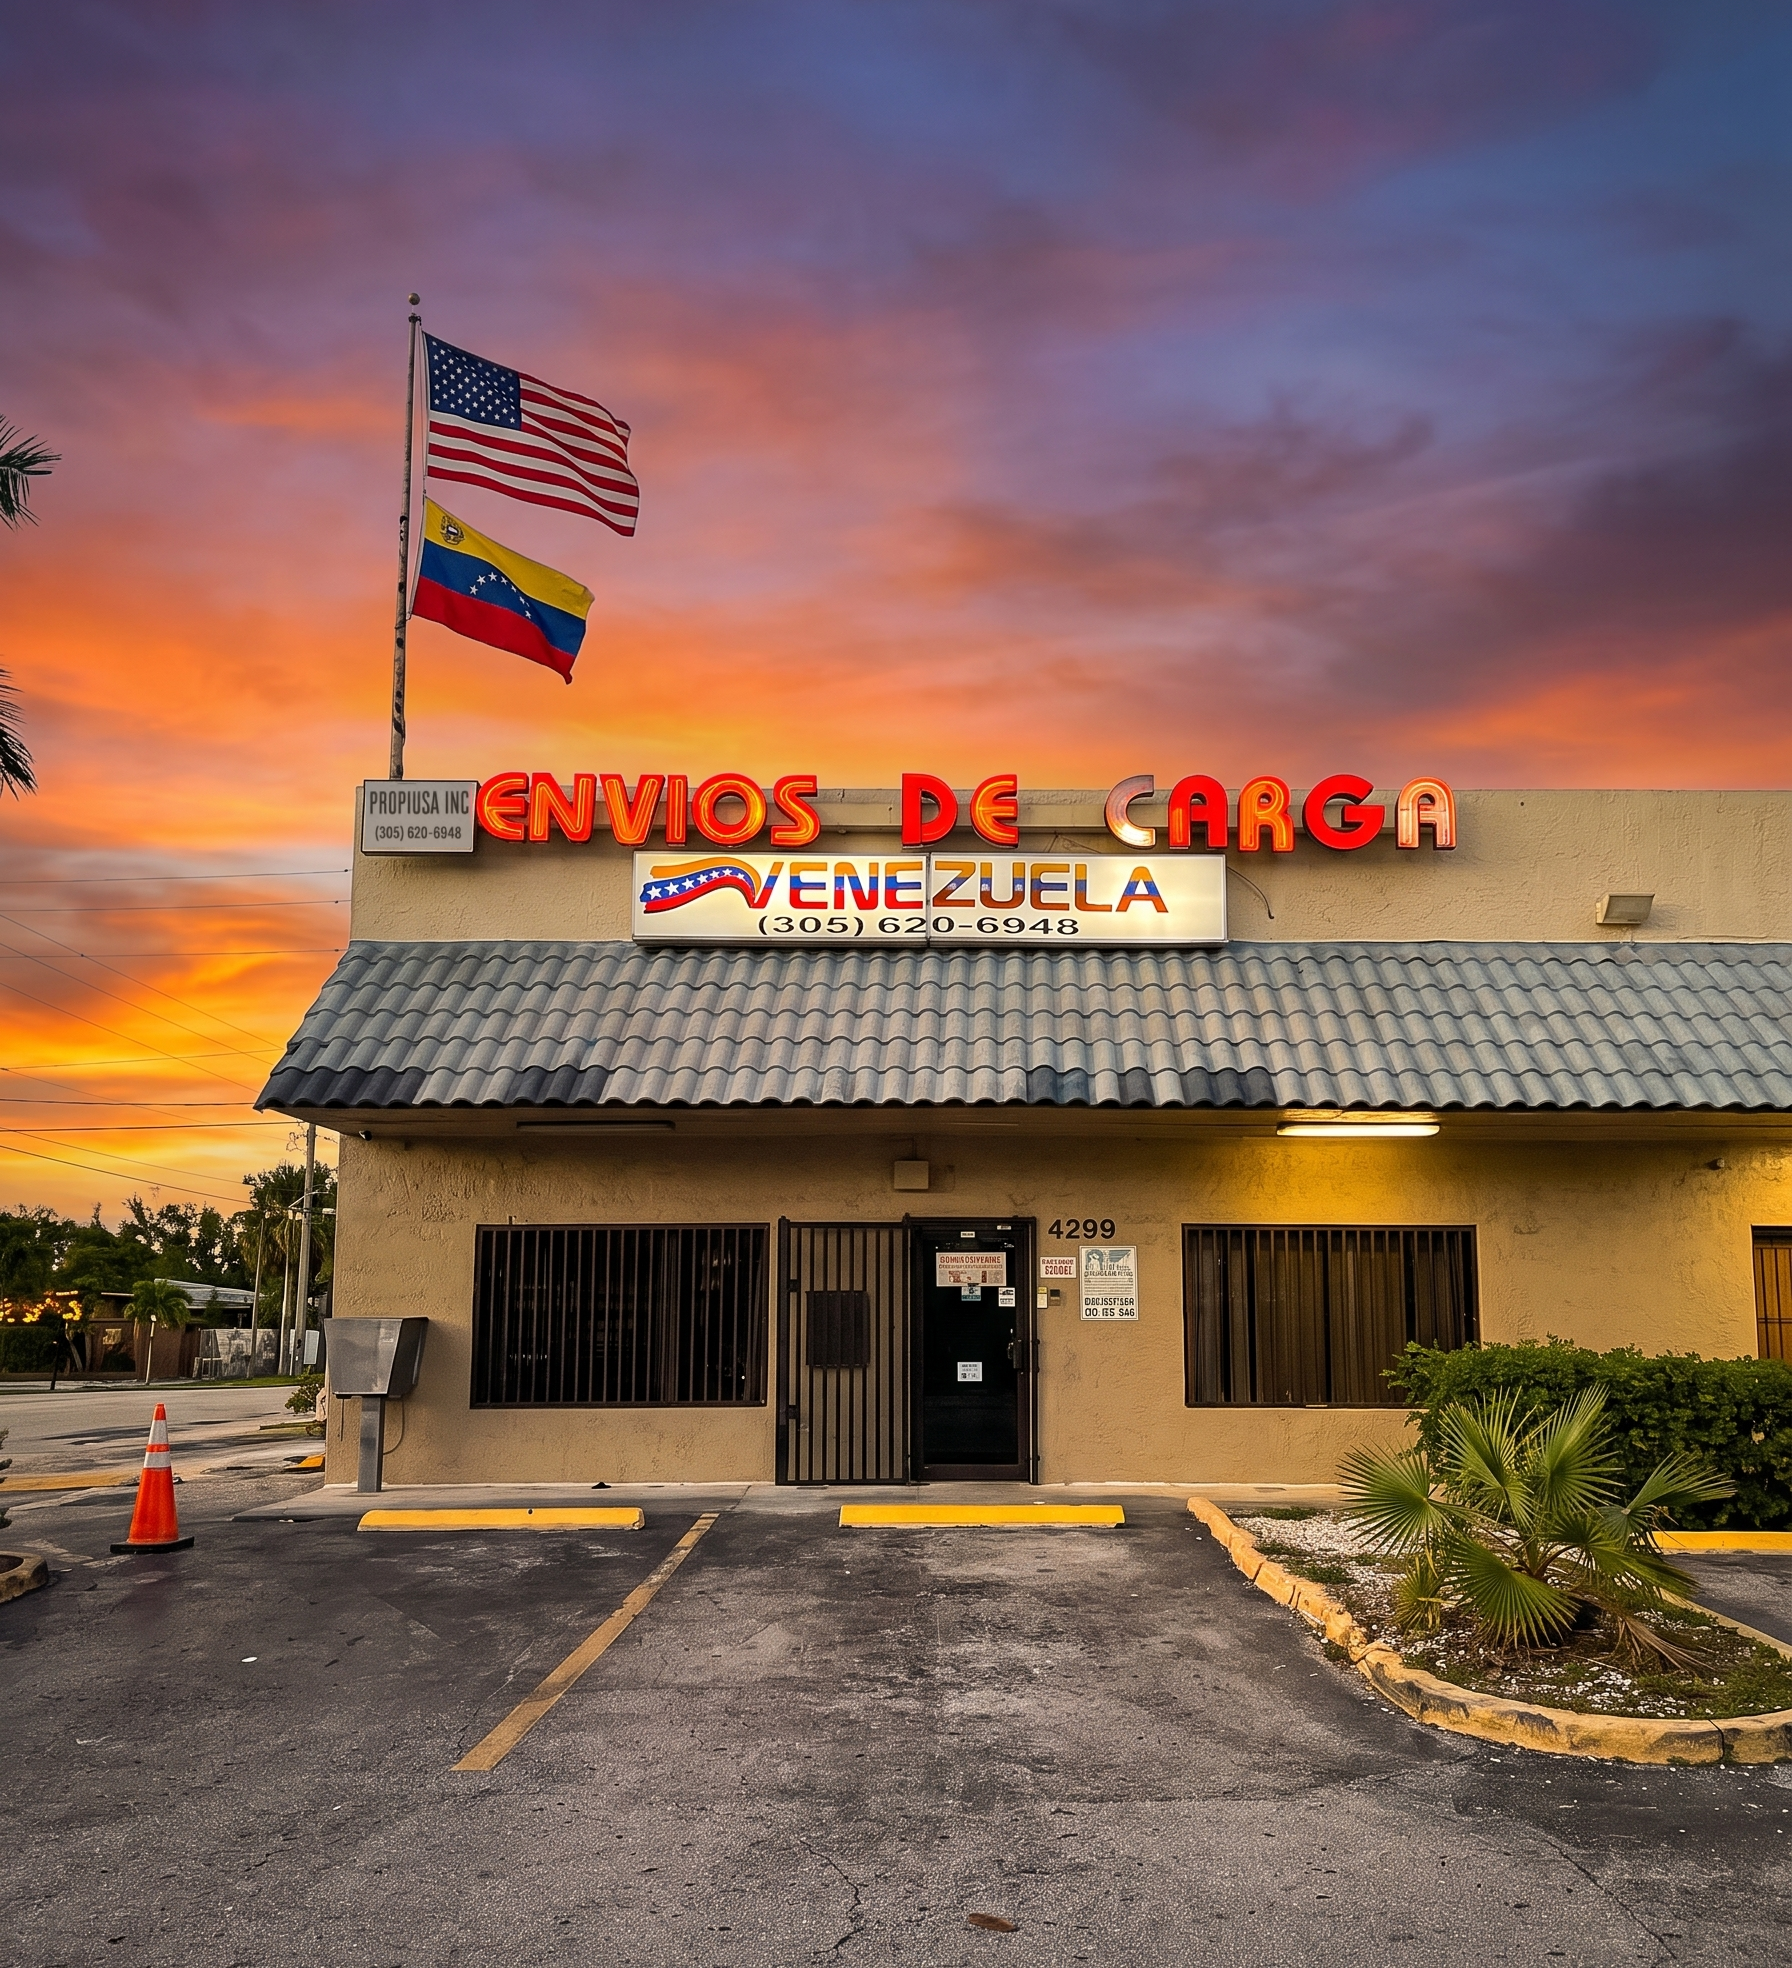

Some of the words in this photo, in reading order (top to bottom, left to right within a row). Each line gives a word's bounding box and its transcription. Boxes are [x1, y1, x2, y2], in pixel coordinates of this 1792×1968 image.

[369, 790, 440, 815] PROPIUSA
[444, 790, 470, 815] INC
[476, 772, 821, 847] ENVIOS
[901, 772, 1019, 848] DE
[1103, 773, 1457, 852] CARGA
[375, 825, 405, 842] (305)
[407, 826, 462, 839] 620-6948
[746, 860, 1170, 914] VENEZUELA
[757, 915, 864, 937] (305)
[877, 916, 1080, 936] 620-6948
[1048, 1218, 1116, 1240] 4299
